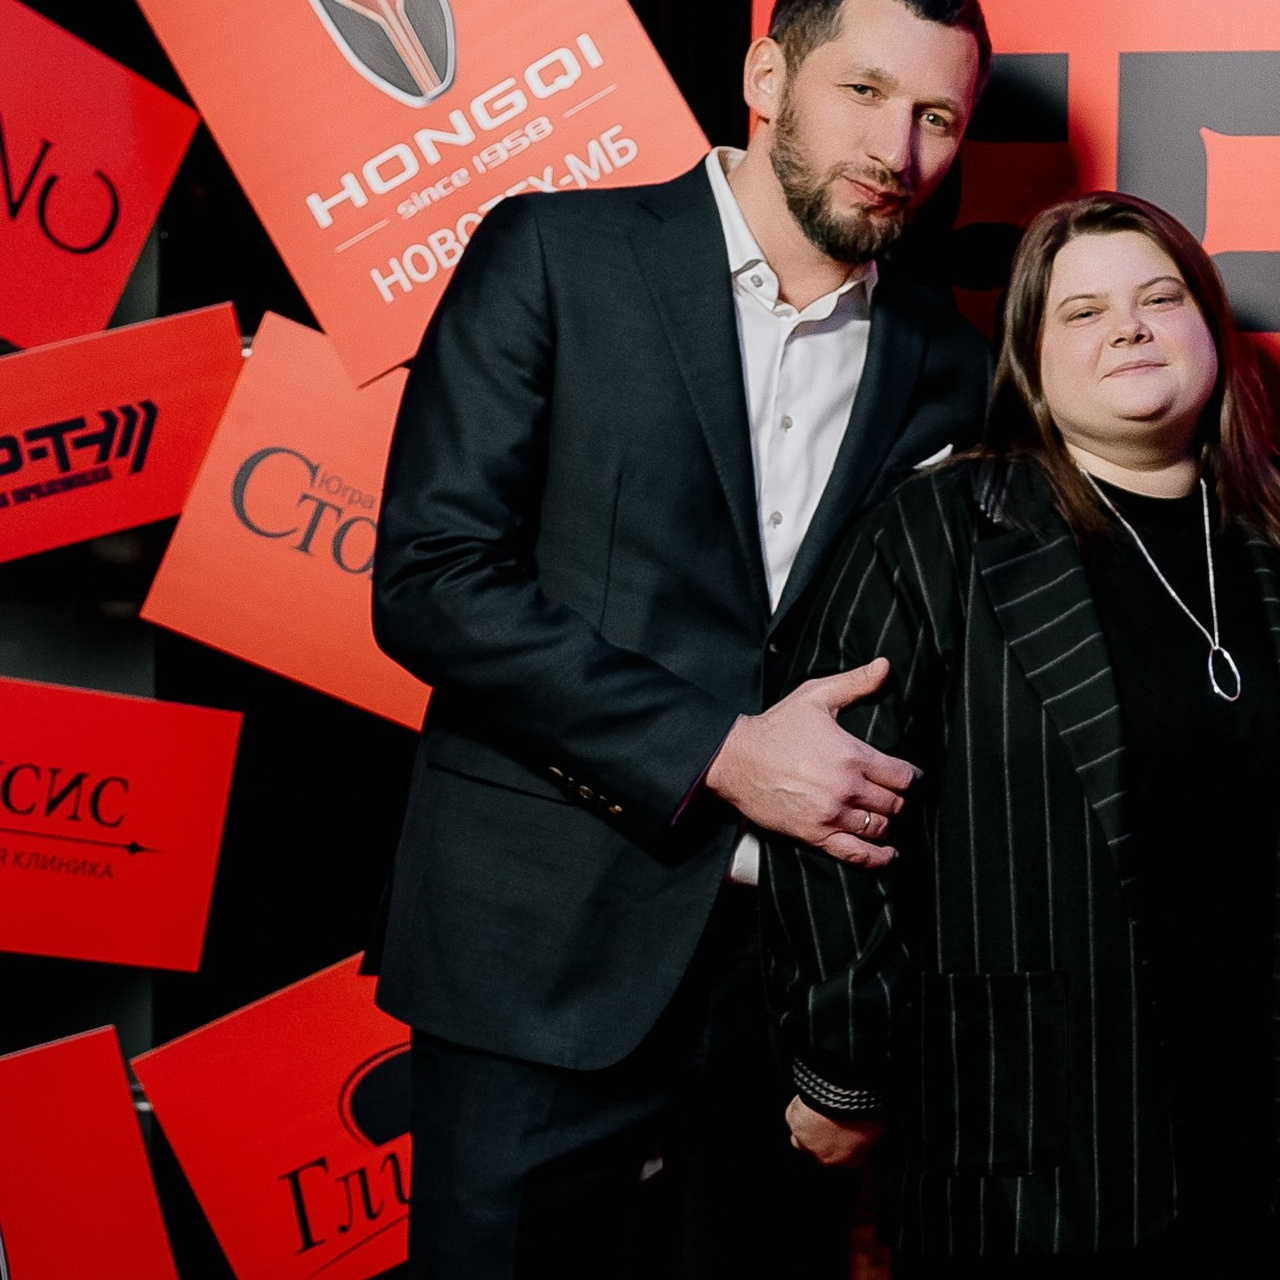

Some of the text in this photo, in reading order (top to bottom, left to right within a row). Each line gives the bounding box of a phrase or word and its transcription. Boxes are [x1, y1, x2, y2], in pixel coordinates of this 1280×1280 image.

[305, 32, 604, 230] HONGQI
[395, 115, 554, 221] since 1958
[230, 446, 378, 581] Сто
[0, 759, 130, 829] СИС
